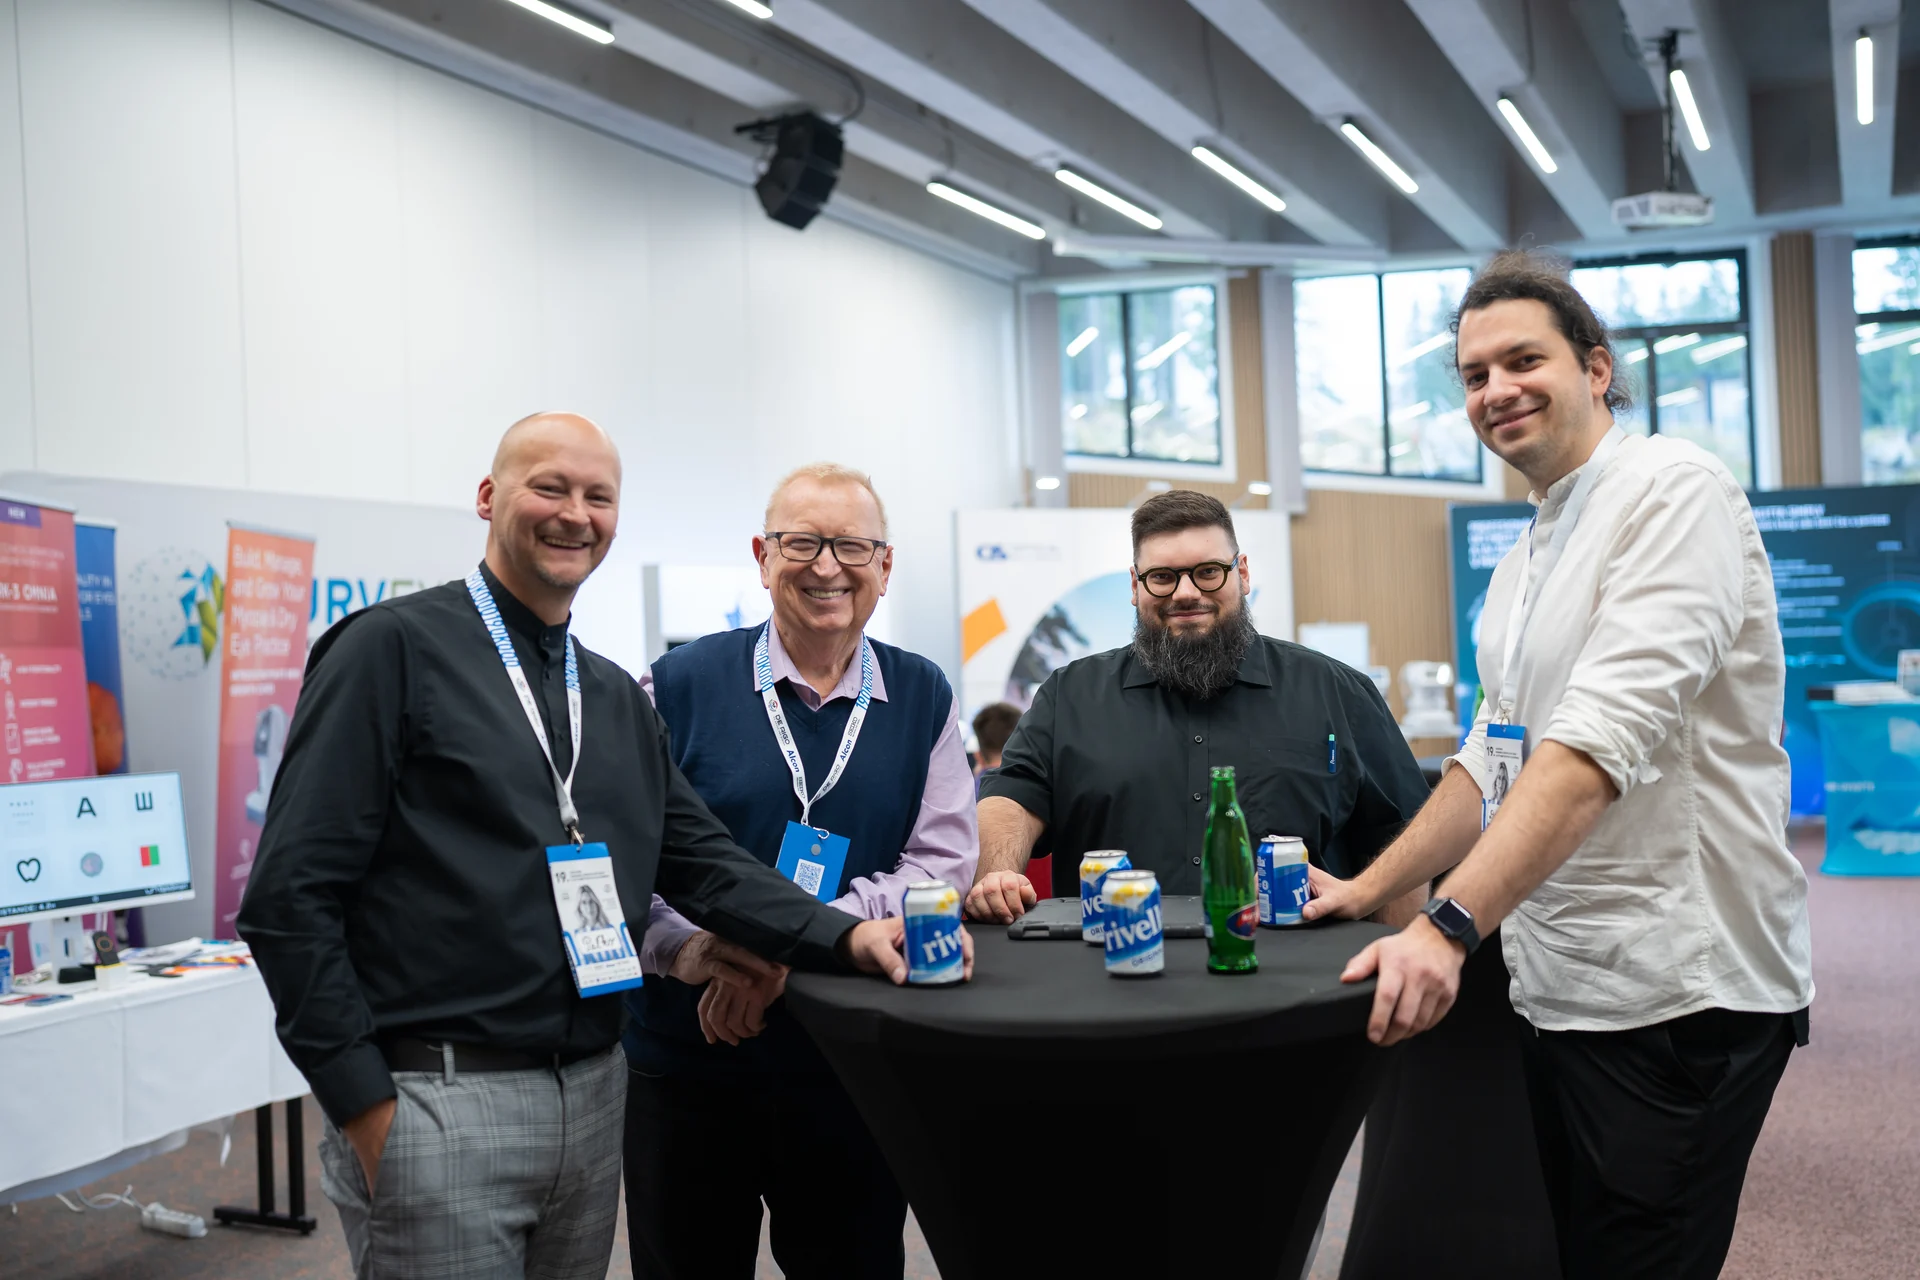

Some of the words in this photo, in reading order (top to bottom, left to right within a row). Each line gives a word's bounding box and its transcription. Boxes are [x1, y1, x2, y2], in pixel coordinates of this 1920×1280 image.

[775, 714, 784, 726] DE
[787, 749, 800, 773] Alcon
[840, 739, 853, 762] Alcon
[76, 797, 97, 819] A
